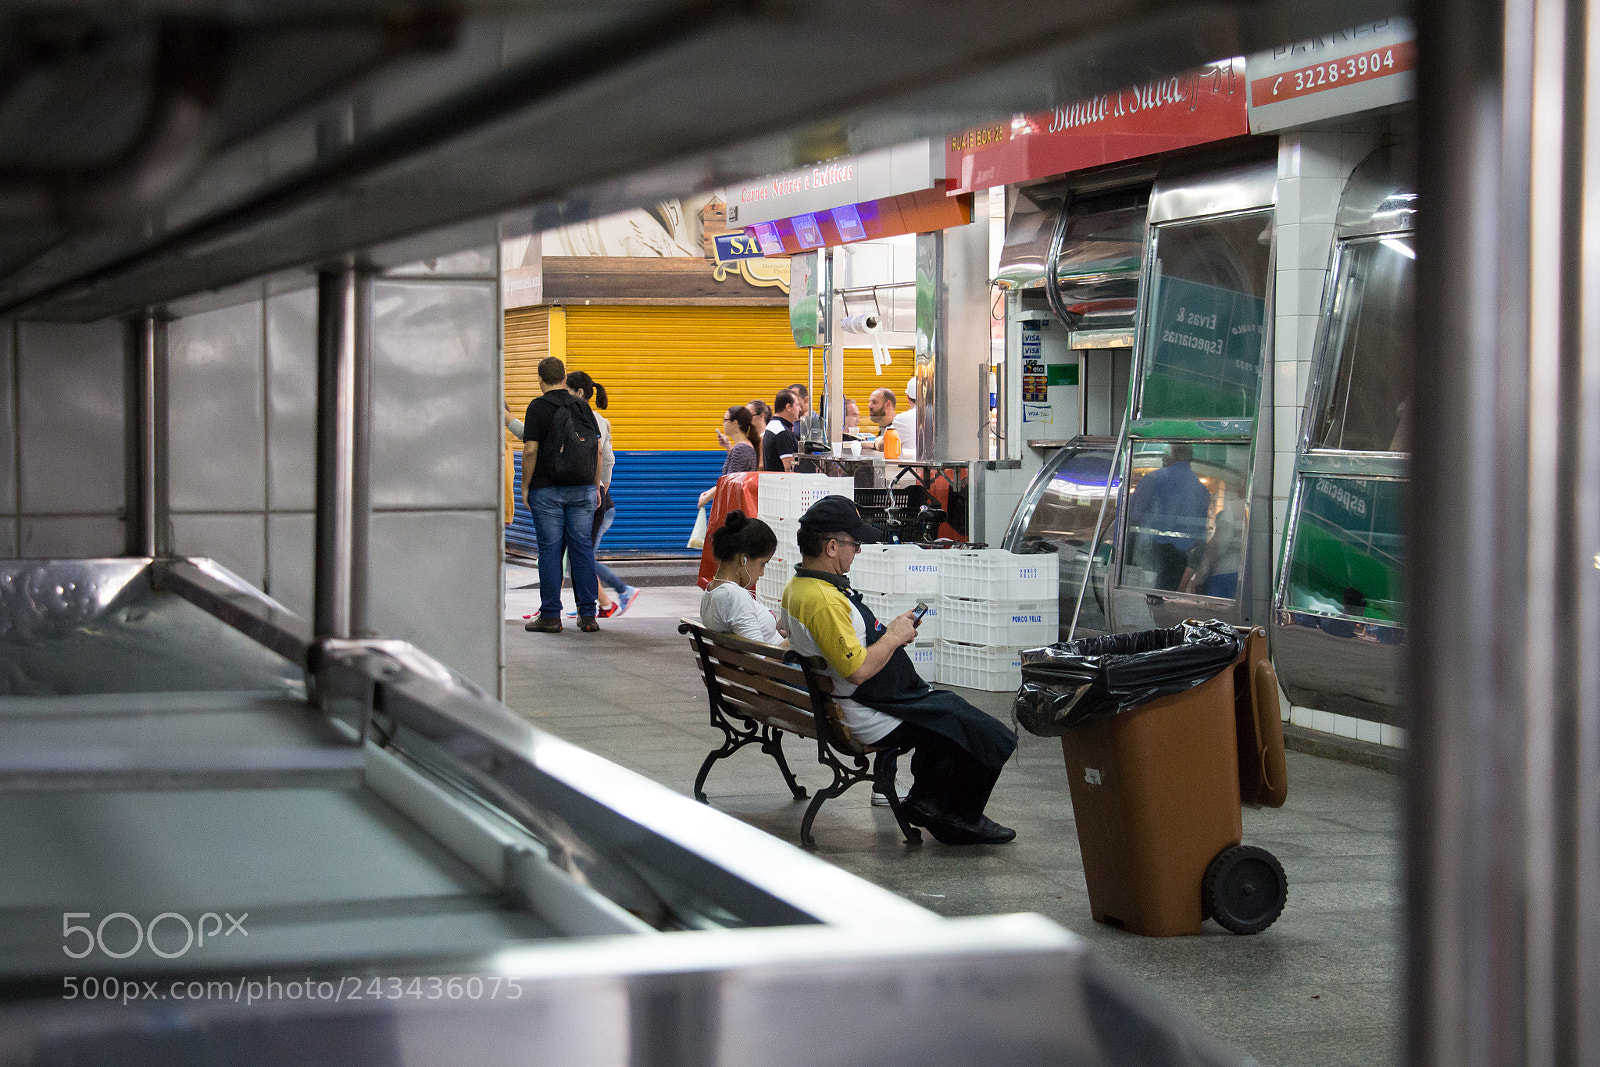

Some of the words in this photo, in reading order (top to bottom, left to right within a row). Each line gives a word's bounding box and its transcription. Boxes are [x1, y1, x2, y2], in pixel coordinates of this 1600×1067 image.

[1294, 49, 1394, 92] 3228-3904
[741, 184, 768, 203] Carnes
[772, 178, 801, 197] Nobres
[804, 176, 810, 190] e
[812, 164, 853, 189] Exóticas
[730, 236, 763, 255] SA
